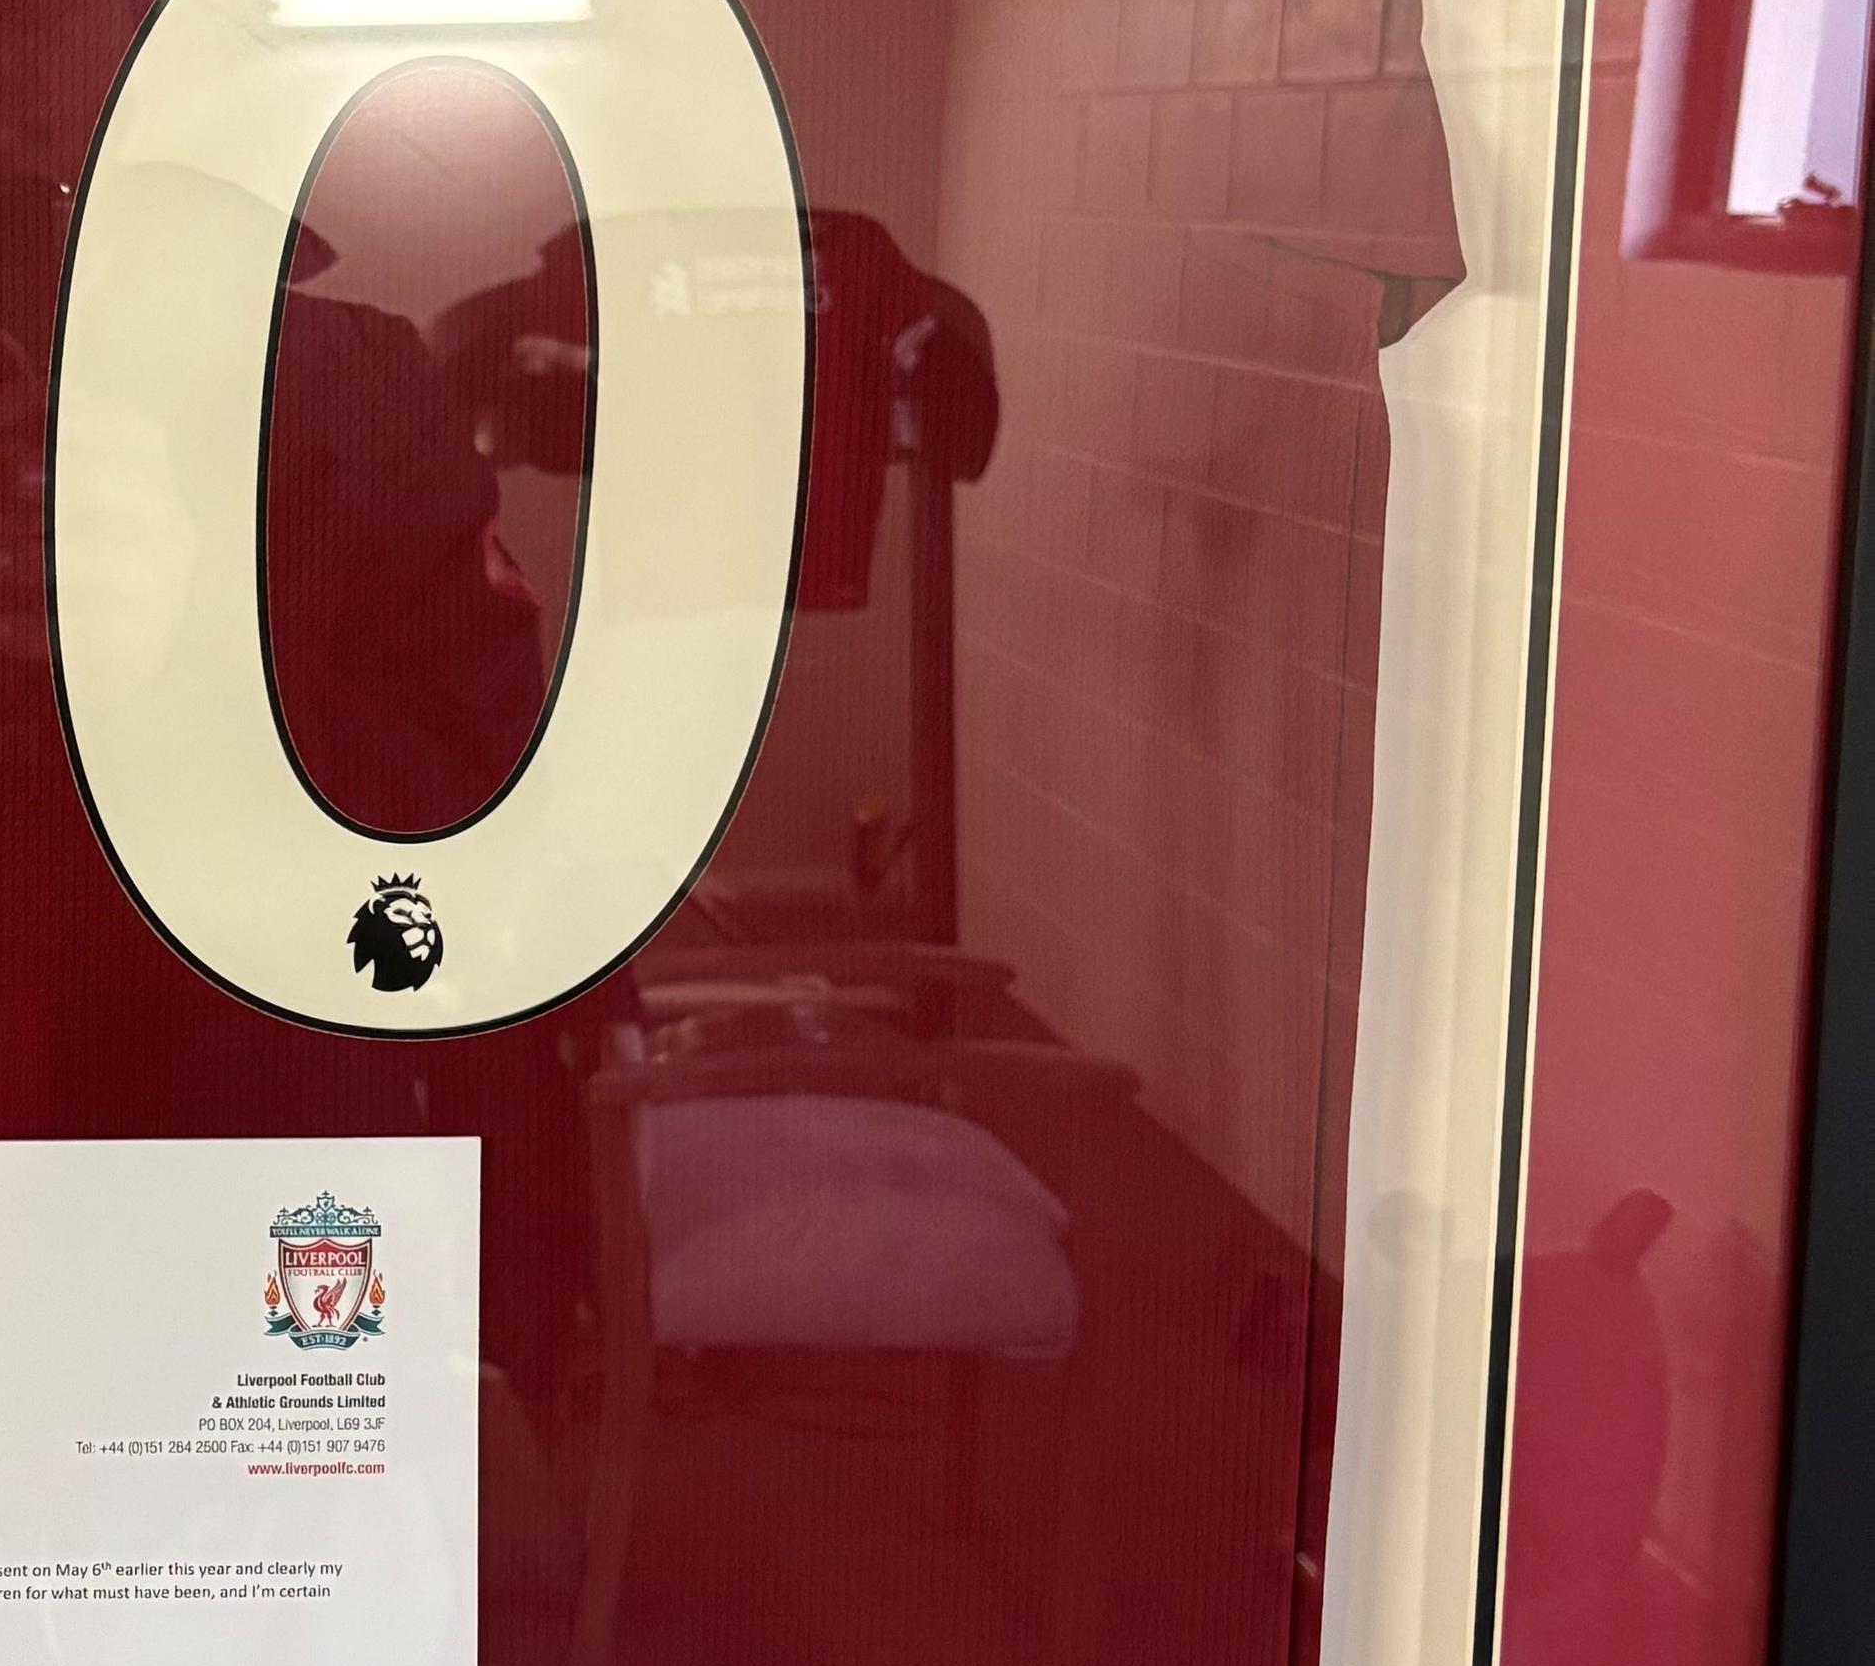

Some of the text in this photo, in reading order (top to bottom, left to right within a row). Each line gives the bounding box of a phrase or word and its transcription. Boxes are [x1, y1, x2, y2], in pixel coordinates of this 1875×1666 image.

[285, 1251, 366, 1266] LIVERPOOL
[288, 1268, 335, 1277] FOOTBALL
[237, 1373, 385, 1389] Liverpool Football Club
[212, 1395, 386, 1409] & Athletic Grounds Limited
[199, 1418, 217, 1431] PO
[219, 1418, 245, 1431] BOX
[247, 1418, 275, 1433] 204,
[337, 1417, 361, 1431] L69
[99, 1441, 124, 1454] +44
[128, 1441, 165, 1456] (0)151
[196, 1440, 227, 1453] 2500
[259, 1440, 283, 1453] +44
[287, 1440, 321, 1455] (0)151
[327, 1440, 349, 1453] 907
[354, 1439, 385, 1452] 9476
[247, 1462, 385, 1477] www.liverpoolfc.com
[32, 1567, 51, 1578] on
[56, 1564, 89, 1579] May
[113, 1562, 164, 1576] earlier
[168, 1562, 195, 1575] this
[199, 1565, 232, 1579] year
[236, 1561, 263, 1575] and
[267, 1561, 318, 1578] clearly
[320, 1564, 343, 1578] my
